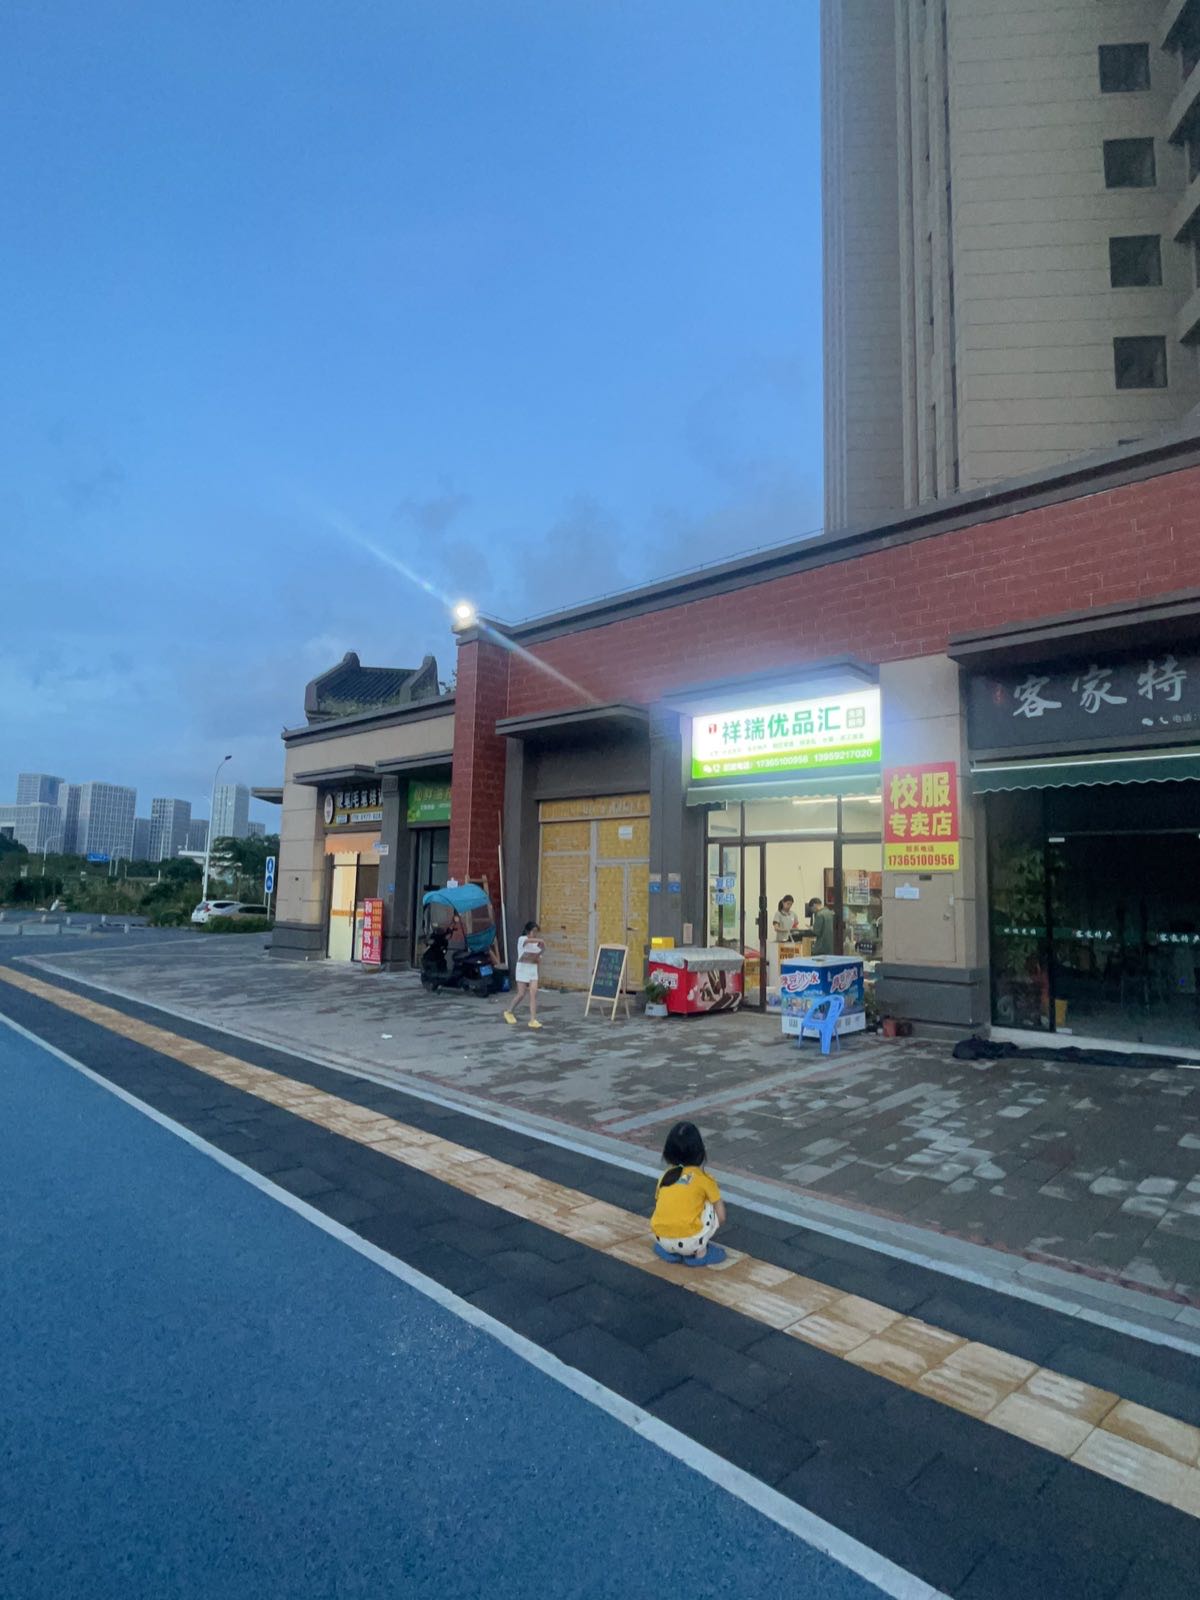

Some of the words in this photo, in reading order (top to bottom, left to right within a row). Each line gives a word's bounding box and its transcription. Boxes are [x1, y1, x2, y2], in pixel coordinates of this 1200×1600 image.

[1013, 655, 1187, 718] 客家特
[722, 706, 841, 745] 祥瑞优品汇
[890, 772, 951, 809] 校服
[889, 811, 953, 837] 专卖店
[888, 854, 955, 867] 17365100956
